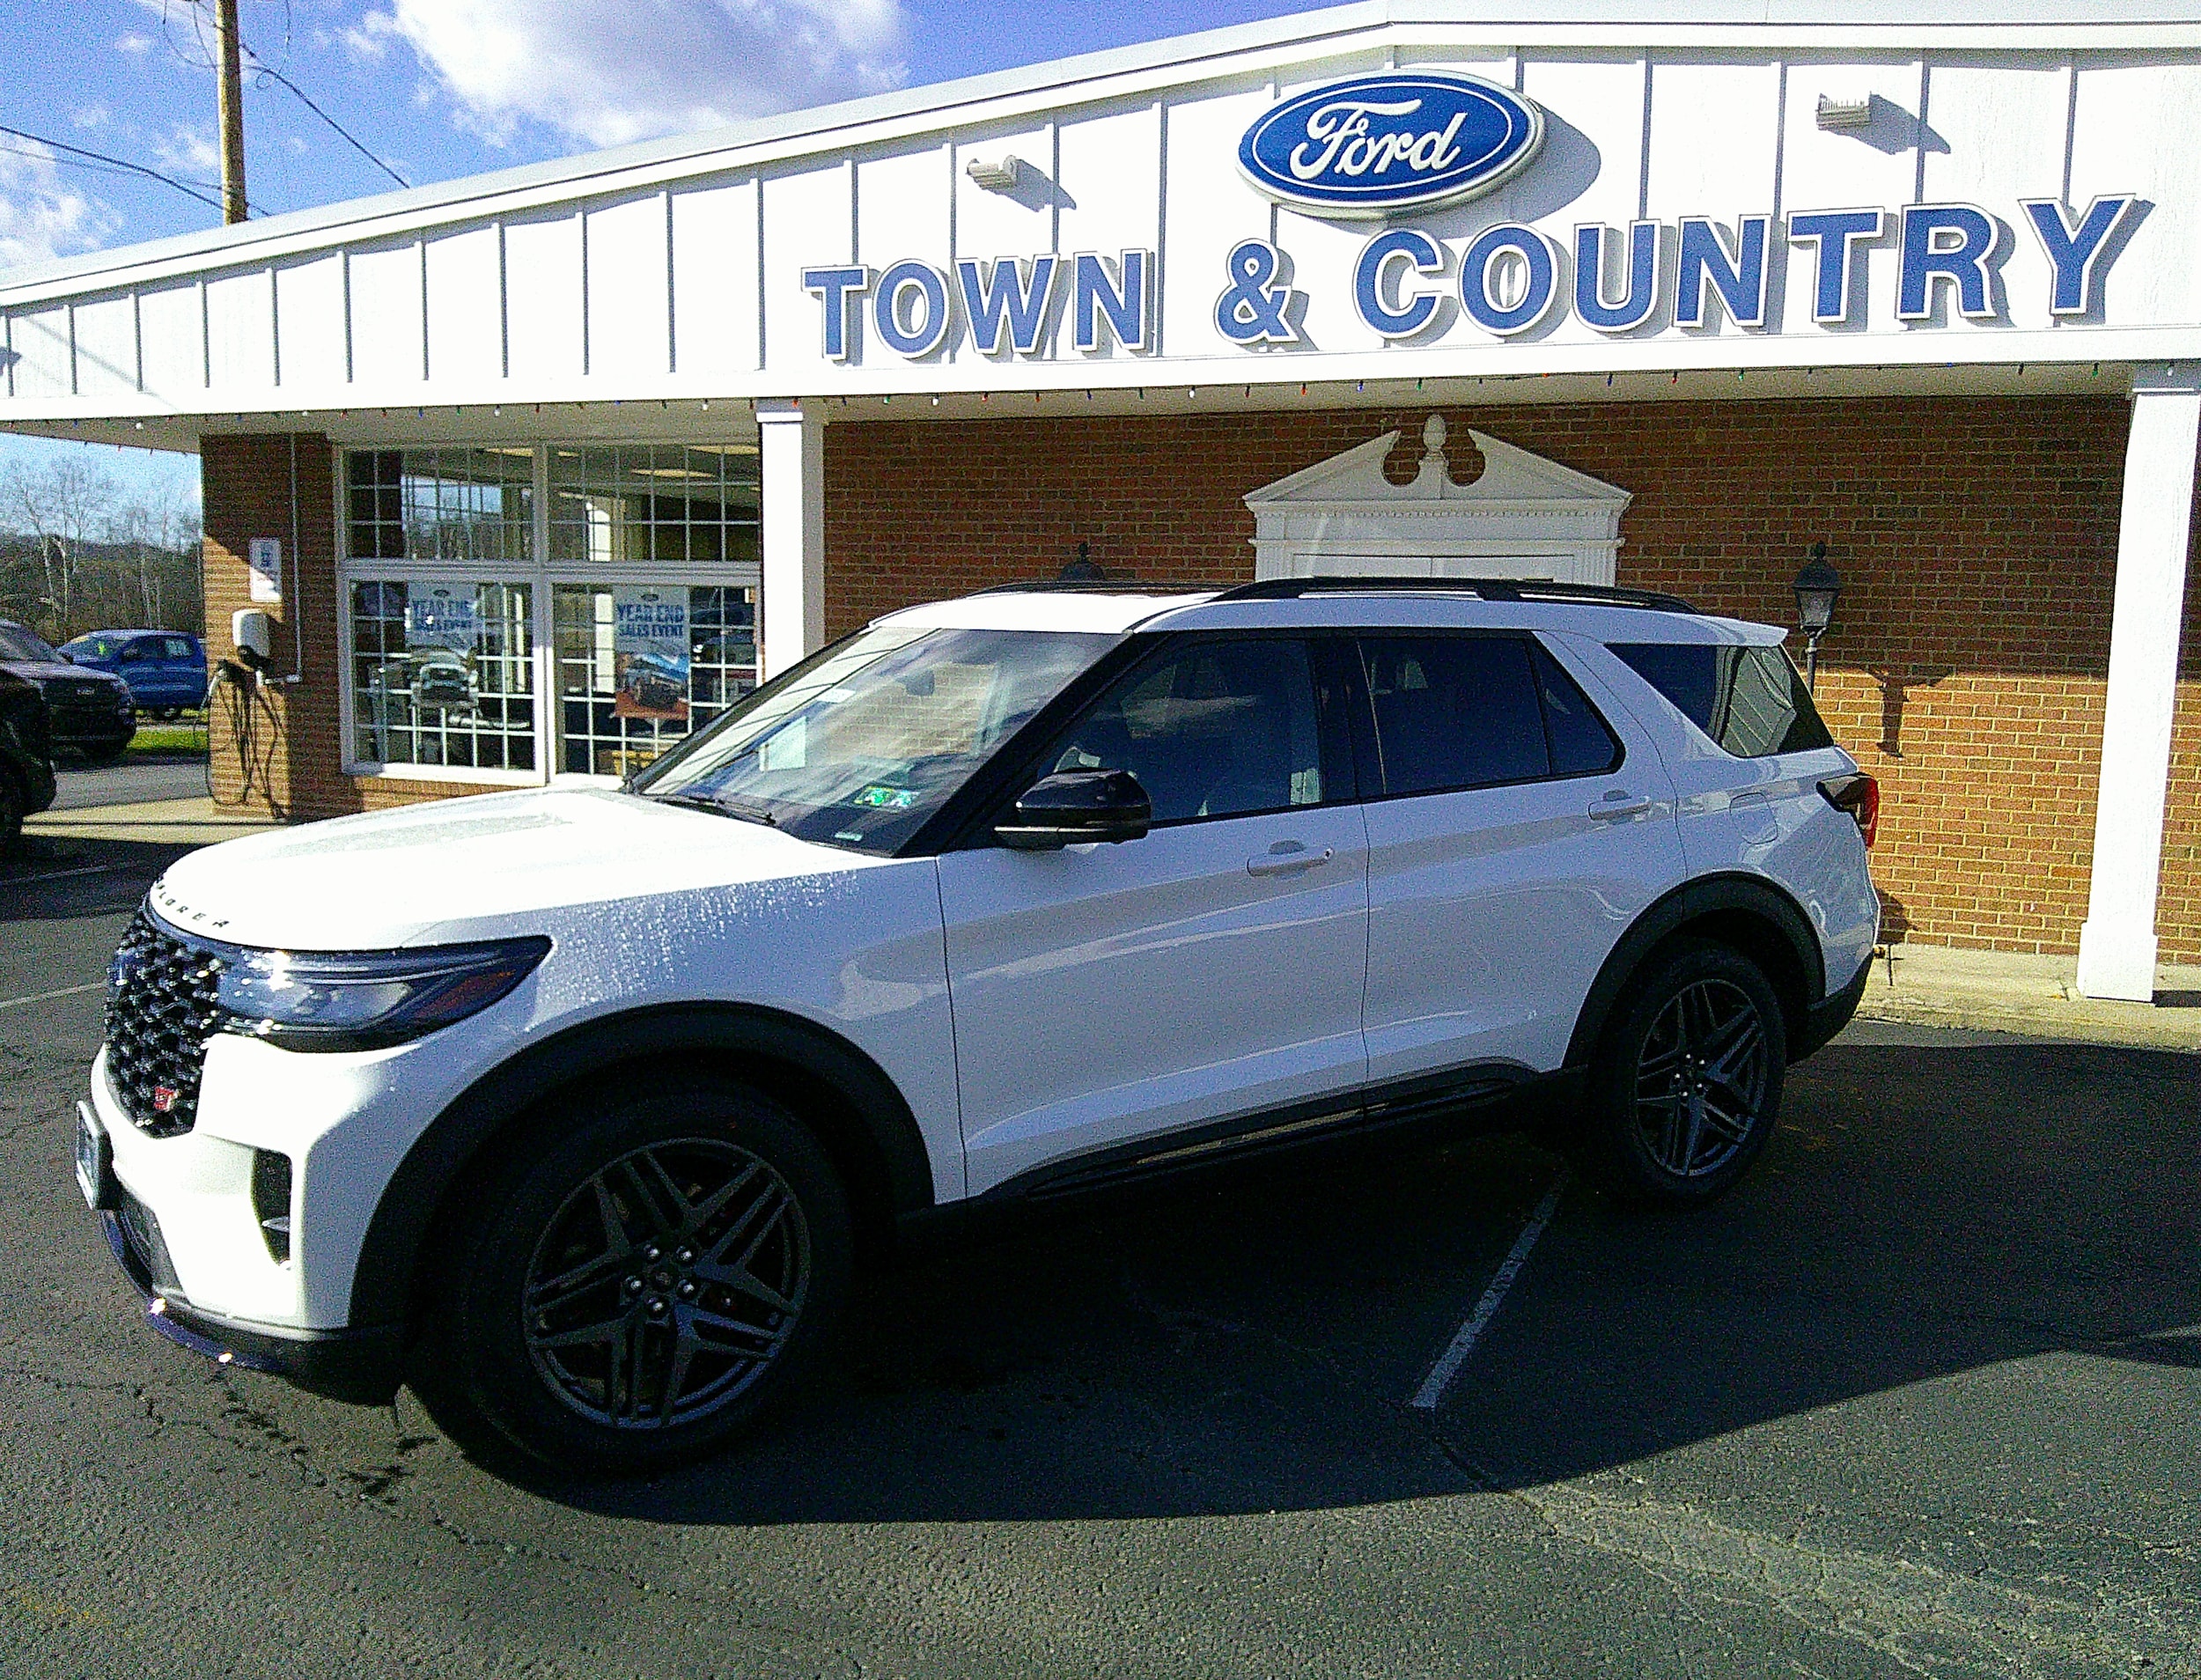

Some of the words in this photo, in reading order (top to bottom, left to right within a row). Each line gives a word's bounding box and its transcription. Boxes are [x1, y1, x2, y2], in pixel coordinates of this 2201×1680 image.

[1289, 98, 1468, 181] Ford
[802, 249, 1147, 359] TOWN
[1214, 238, 1292, 343] &
[1353, 193, 2136, 340] COUNTRY
[617, 604, 652, 622] YEAR
[656, 605, 684, 622] END
[618, 623, 650, 637] SALES
[651, 624, 684, 637] EVENT
